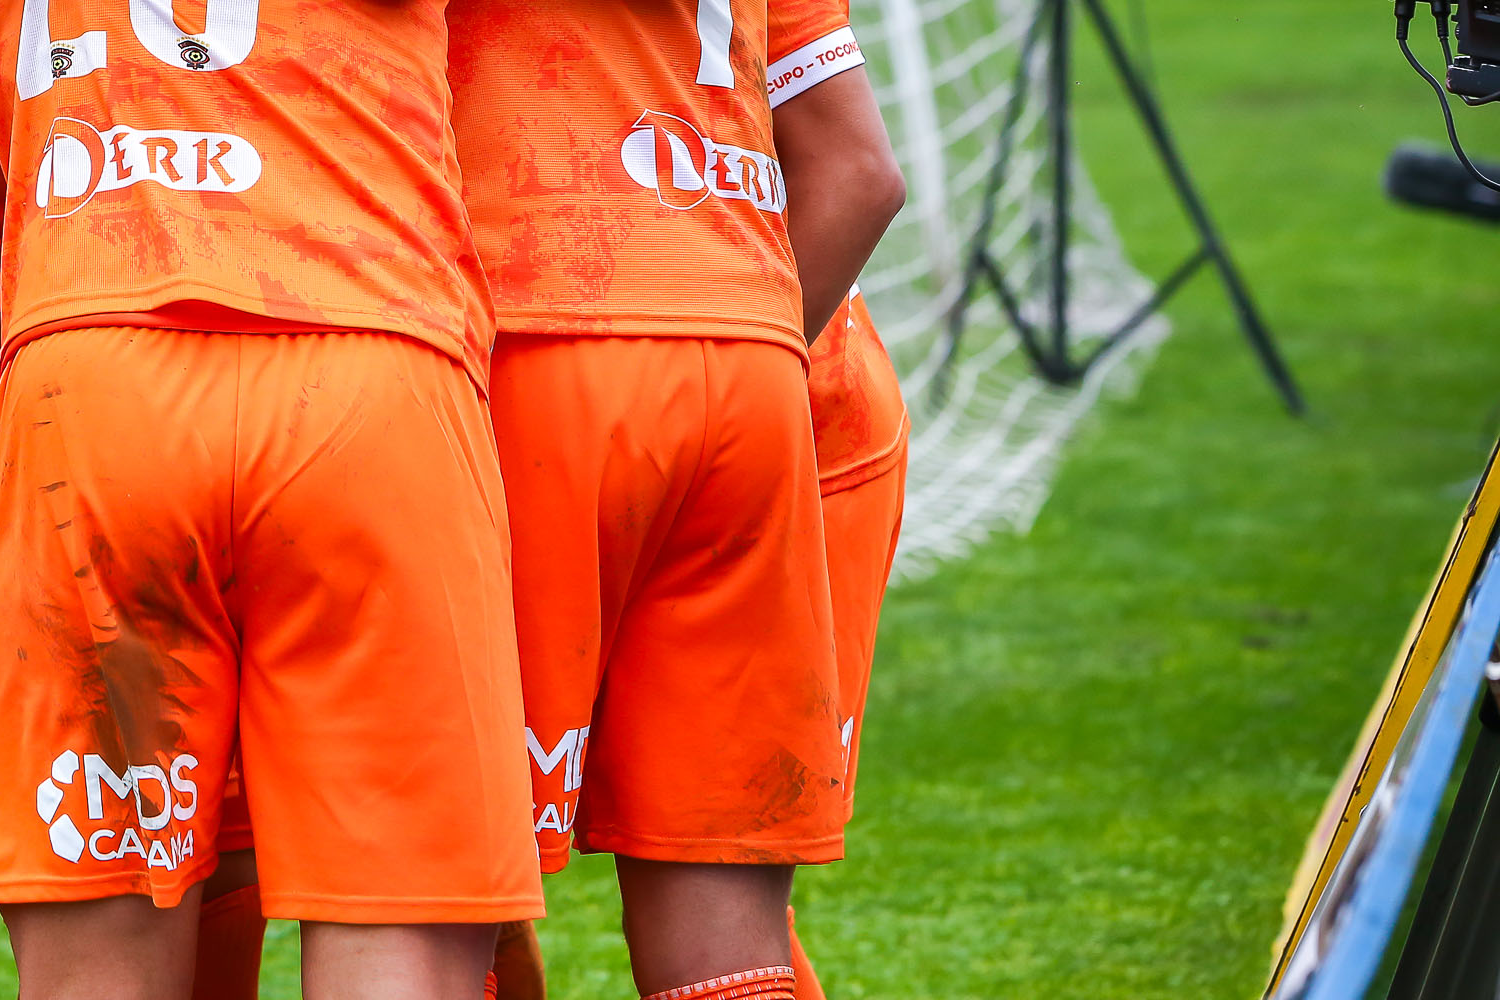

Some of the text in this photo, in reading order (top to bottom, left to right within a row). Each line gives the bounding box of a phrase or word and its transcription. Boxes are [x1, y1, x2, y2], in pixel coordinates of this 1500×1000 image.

[36, 117, 262, 218] DERK
[83, 753, 199, 831] MDS
[88, 829, 194, 872] CAAMA
